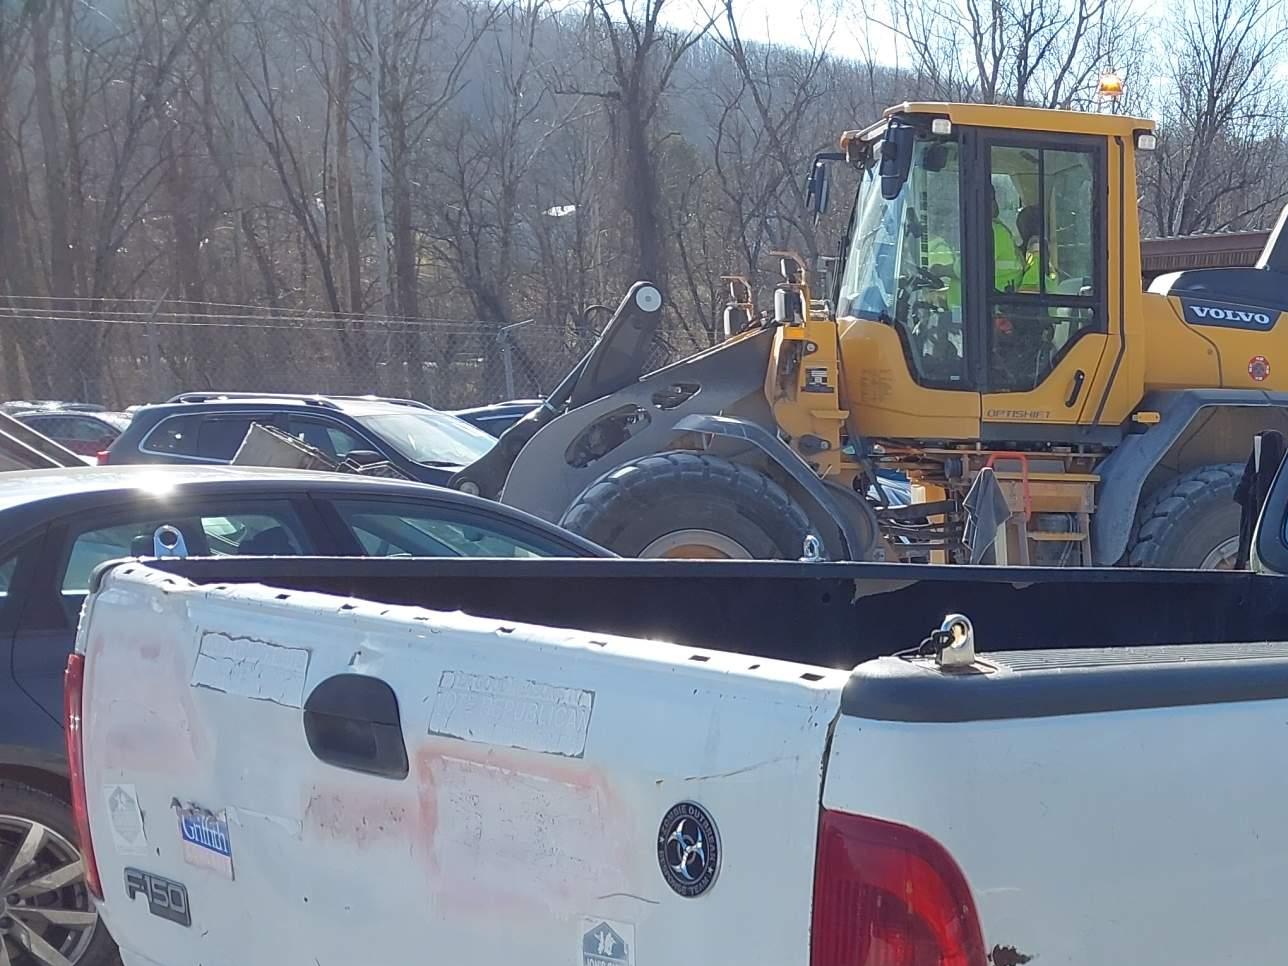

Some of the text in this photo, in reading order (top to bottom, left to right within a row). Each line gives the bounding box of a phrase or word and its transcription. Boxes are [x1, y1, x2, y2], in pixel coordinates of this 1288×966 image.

[1189, 306, 1269, 324] VOLVO
[182, 814, 229, 854] Griffith
[688, 806, 717, 861] OUTBREAK
[689, 871, 712, 896] TEAM
